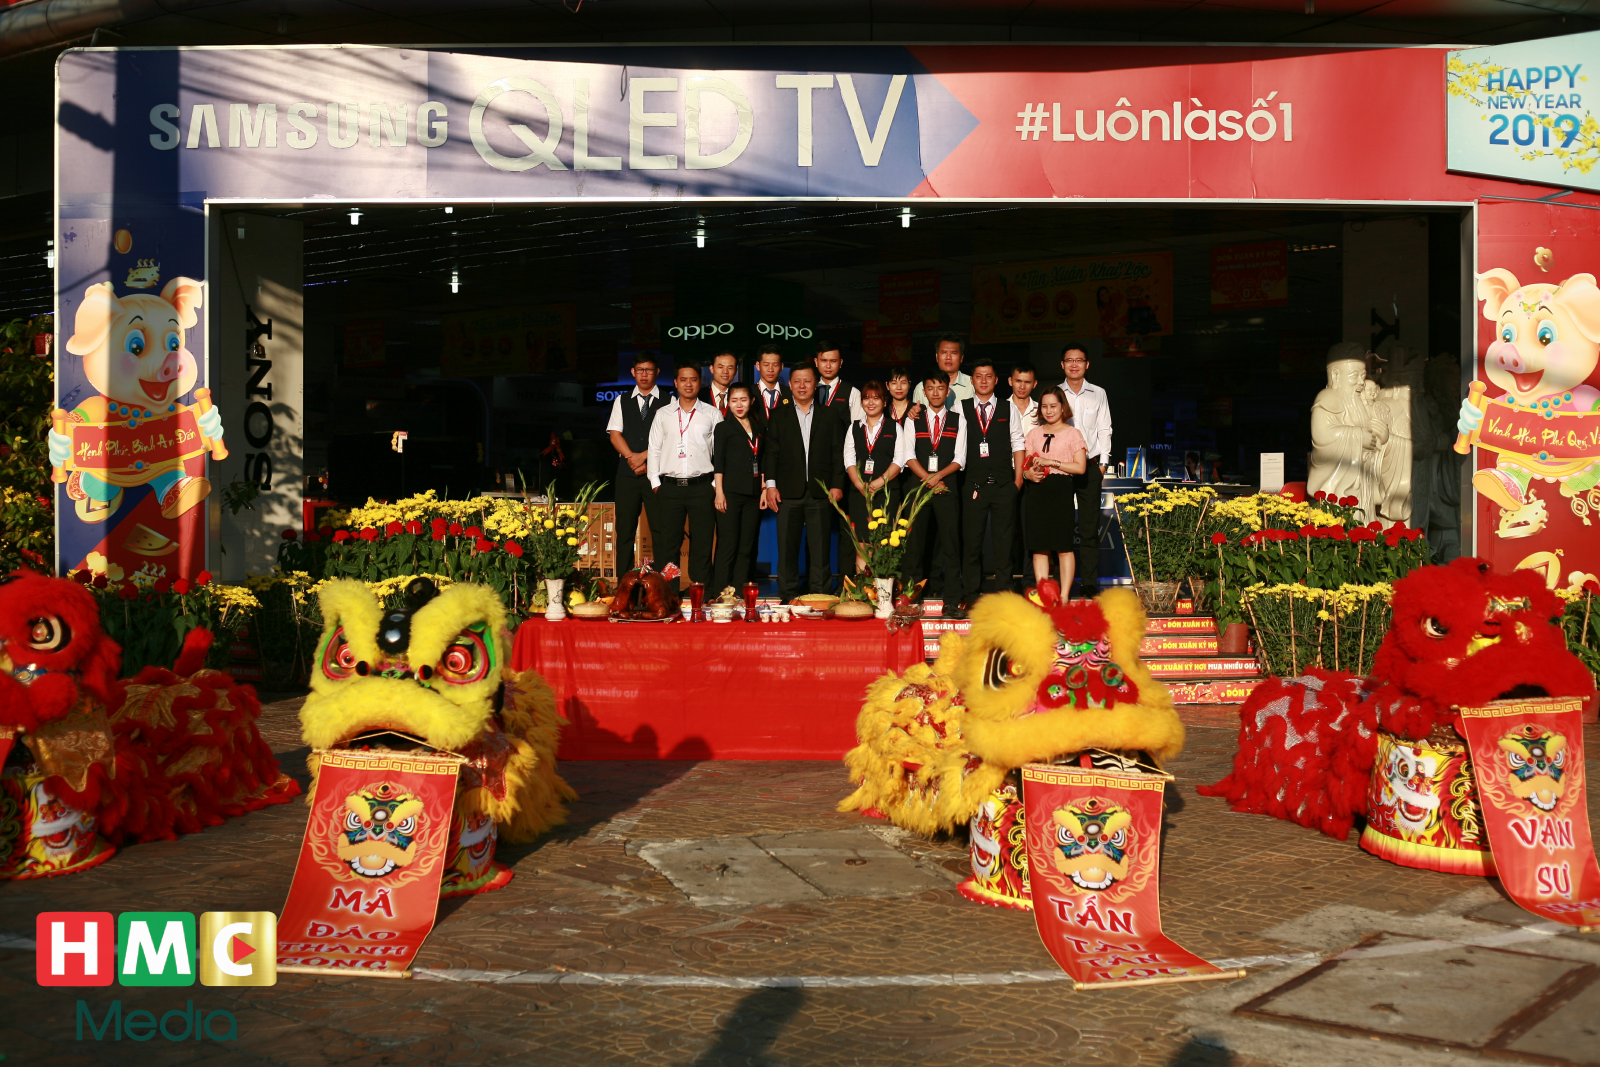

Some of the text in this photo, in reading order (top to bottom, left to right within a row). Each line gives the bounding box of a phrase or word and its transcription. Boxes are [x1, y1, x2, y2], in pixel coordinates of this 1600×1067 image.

[1488, 64, 1582, 92] HAPPY
[1488, 93, 1582, 109] NEW YEAR
[148, 74, 908, 172] SAMSUNG QLED TV
[1015, 90, 1293, 143] #Luônlàsố1
[1489, 114, 1580, 149] 2019
[244, 304, 274, 491] SONY
[935, 622, 954, 630] GIẢM
[1183, 620, 1200, 628] XUÂN
[1162, 641, 1177, 649] ĐÓN
[1178, 641, 1196, 649] XUÂN
[1163, 662, 1183, 670] XUÂN
[1194, 663, 1206, 671] HỢI
[1226, 687, 1244, 697] ĐÓN
[1509, 818, 1575, 854] VẠN
[328, 886, 396, 918] MÃ
[1049, 894, 1139, 938] TẤN
